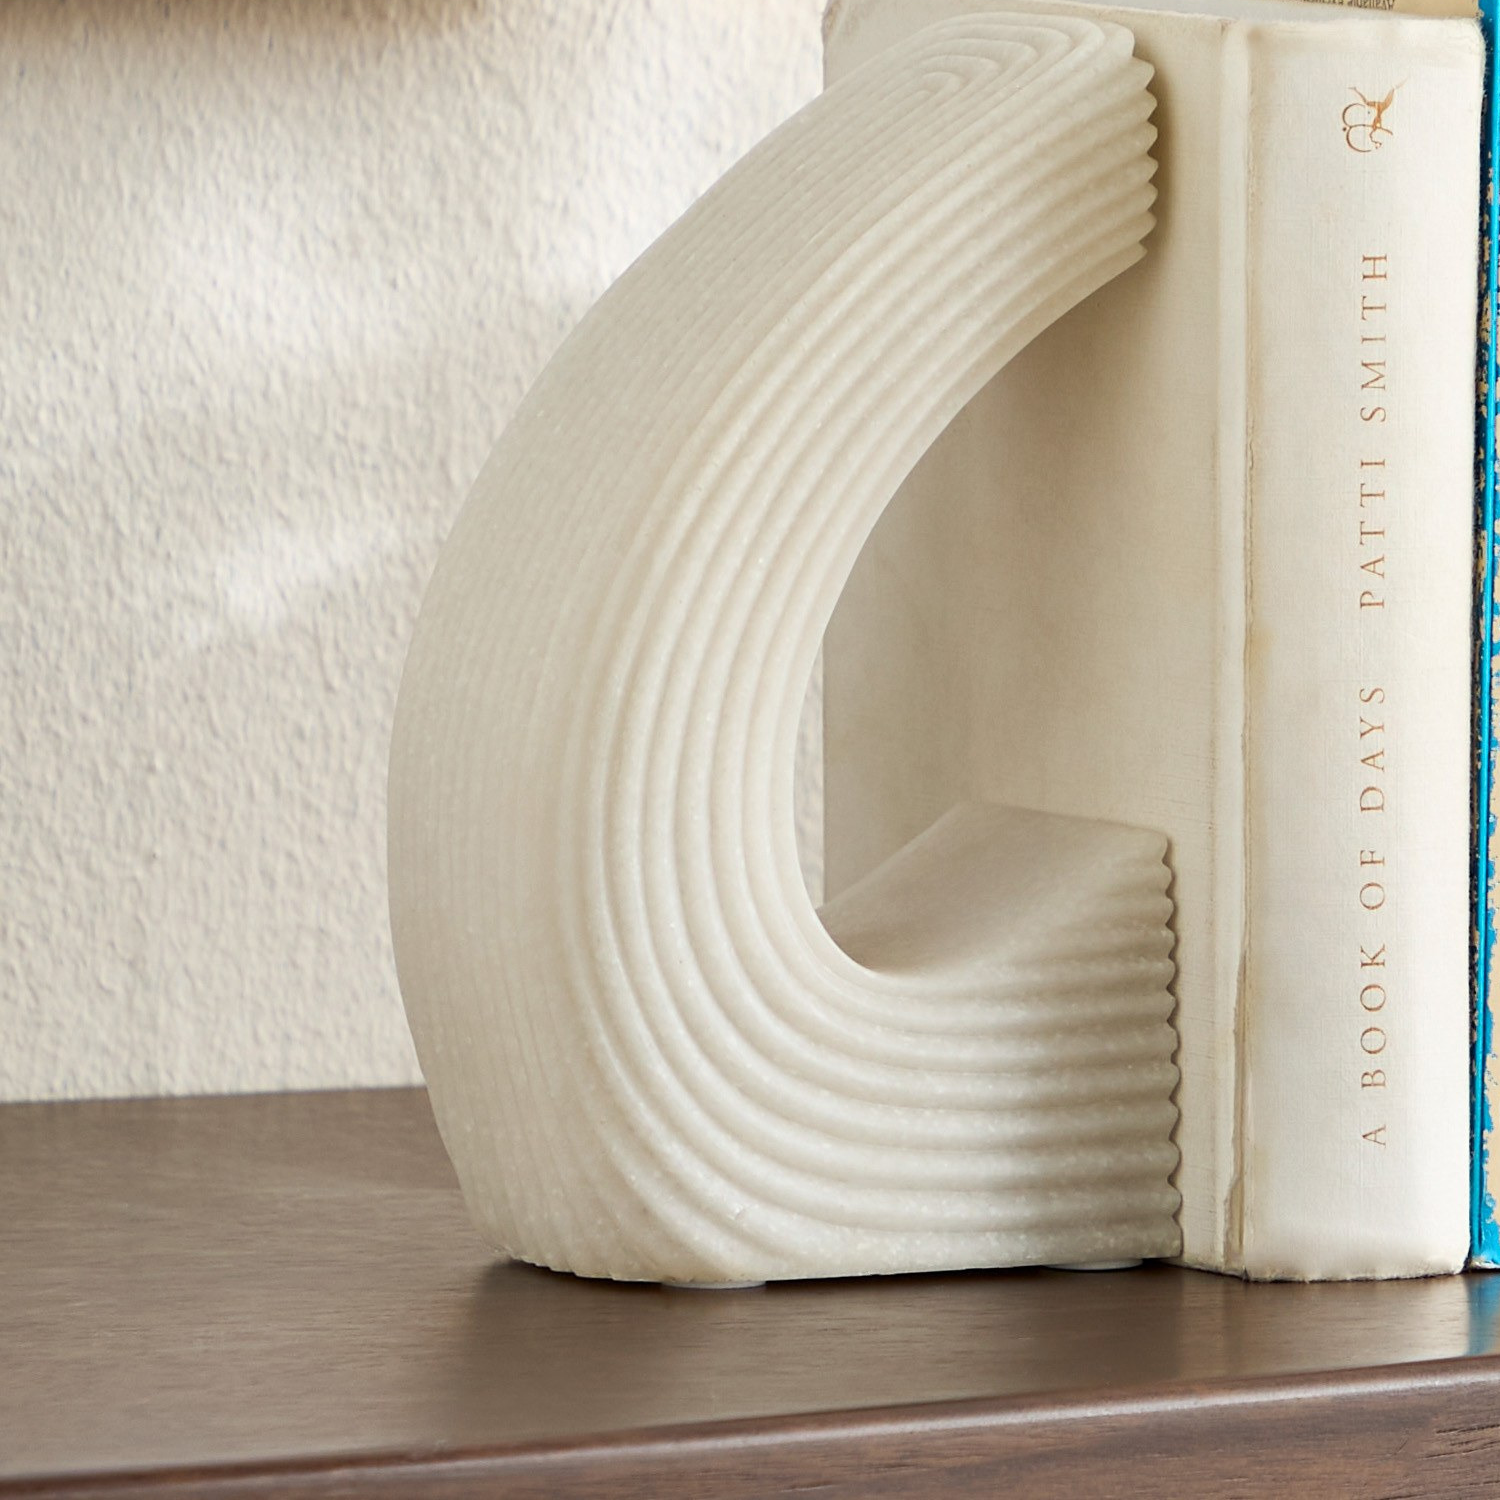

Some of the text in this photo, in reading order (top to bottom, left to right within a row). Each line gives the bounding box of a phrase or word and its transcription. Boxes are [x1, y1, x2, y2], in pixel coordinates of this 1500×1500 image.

[1359, 253, 1389, 1148] A BOOK OF DAYS PATTI SMITH
